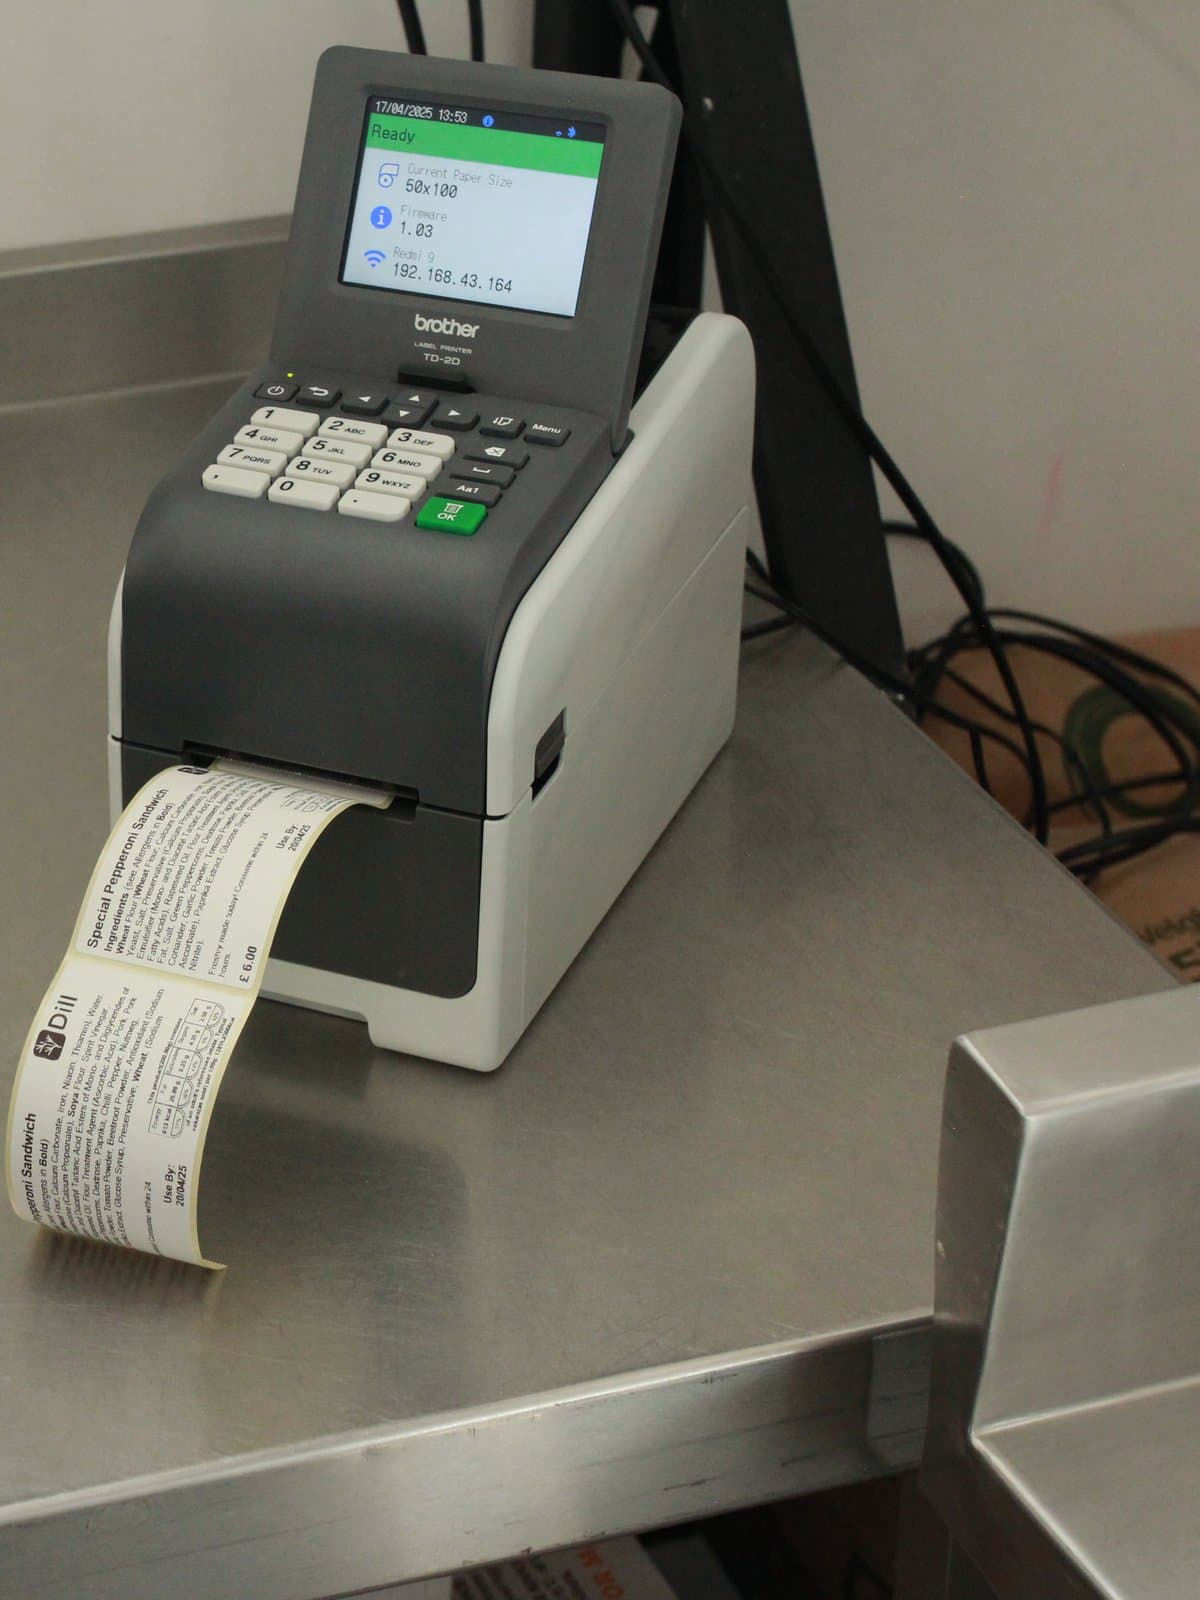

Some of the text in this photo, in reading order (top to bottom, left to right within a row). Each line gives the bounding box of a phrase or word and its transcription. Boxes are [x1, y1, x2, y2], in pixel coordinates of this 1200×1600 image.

[375, 101, 467, 123] 17/04/2025 13:53
[371, 124, 415, 144] Ready
[407, 163, 513, 188] Current Paper Size
[406, 179, 457, 199] 50x100
[400, 205, 447, 222] Firmware
[400, 221, 434, 238] 1.03
[393, 263, 512, 293] 192.168.43.164
[414, 314, 480, 339] brother
[414, 341, 472, 355] LABEL PRINTER
[423, 352, 460, 366] TD-2D
[264, 409, 274, 419] 1
[245, 428, 278, 442] 4 GHI
[327, 421, 366, 435] 2 ABC
[532, 422, 561, 435] Menu
[312, 440, 344, 455] 5 JKL
[398, 432, 434, 447] 3 DEF
[229, 448, 271, 464] 7 PQRS
[382, 452, 421, 467] 6 MNO
[296, 460, 333, 475] 8 TUV
[279, 480, 294, 491] 0
[366, 473, 412, 490] 9 WXYZ
[456, 484, 479, 495] Aa1
[437, 512, 456, 521] OK
[275, 834, 290, 848] Use
[288, 823, 311, 851] 20/04/25
[88, 789, 168, 948] Special Pepperoni Sandwich
[105, 893, 128, 951] Ingredients
[125, 870, 137, 890] (see
[133, 830, 156, 867] Allergens
[156, 802, 175, 821] Bold)
[116, 925, 130, 954] Wheat
[125, 901, 138, 922] Flour
[239, 945, 258, 982] £ 6.00
[48, 995, 77, 1029] Dill
[67, 1092, 80, 1116] Soya
[81, 1040, 94, 1061] Spirit
[21, 1114, 36, 1177] Sandwich
[39, 1138, 48, 1165] Bold)
[163, 1164, 175, 1202] Use By:
[176, 1165, 187, 1206] 20/04/25
